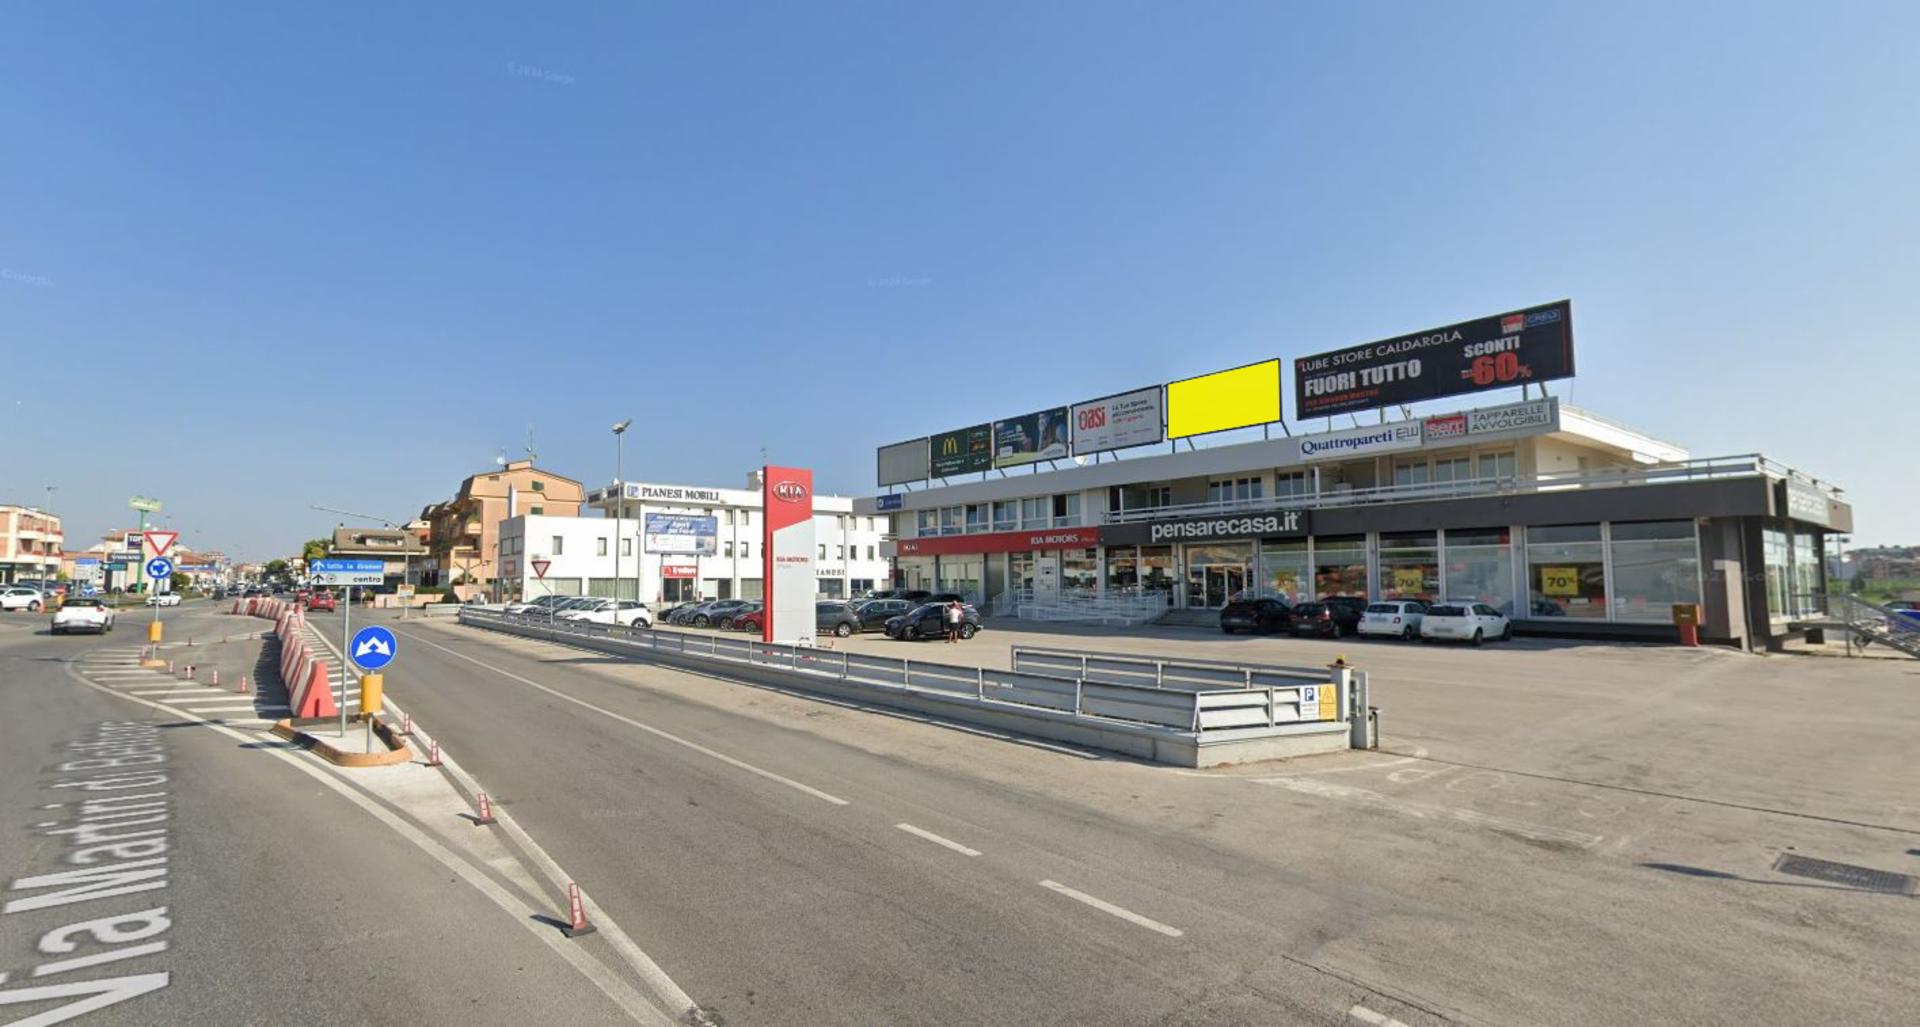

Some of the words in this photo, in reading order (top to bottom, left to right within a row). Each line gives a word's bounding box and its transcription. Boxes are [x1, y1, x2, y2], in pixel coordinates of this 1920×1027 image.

[1302, 358, 1329, 372] LUBE
[1332, 347, 1373, 366] STORE
[1376, 330, 1463, 358] CALDAROLA
[1464, 335, 1520, 358] SCONTI
[1304, 371, 1356, 397] FUORI
[1361, 358, 1422, 387] TUTTO
[1474, 404, 1545, 421] TAPPARELLE
[1472, 414, 1548, 432] AVVOLGIBILI
[1301, 429, 1393, 455] Quattropareti
[641, 487, 683, 498] PIANESI
[685, 489, 720, 501] MOBILI
[779, 485, 803, 497] KIA
[1151, 511, 1298, 543] pensarecasa.it
[1045, 534, 1079, 545] MOTORS
[353, 575, 382, 583] centro
